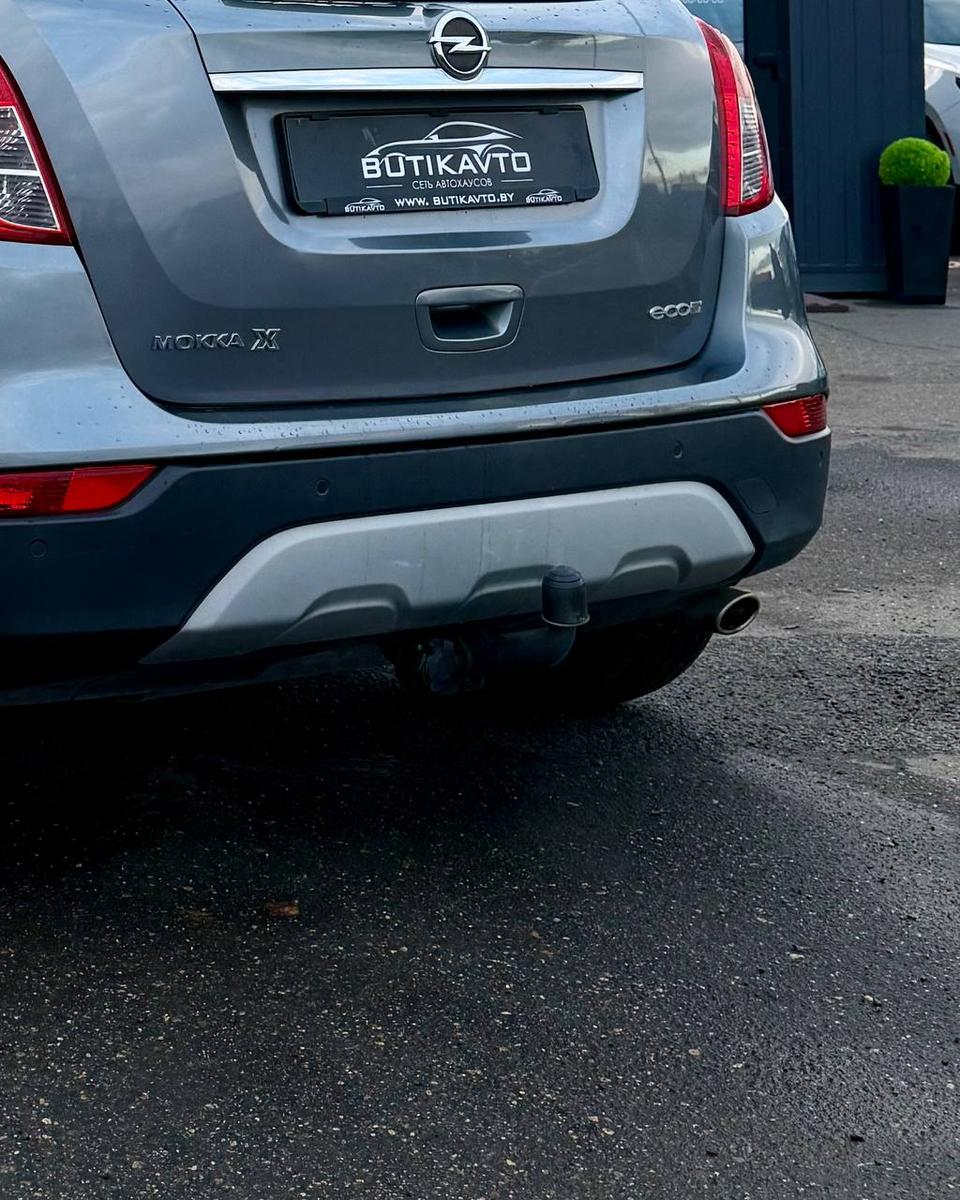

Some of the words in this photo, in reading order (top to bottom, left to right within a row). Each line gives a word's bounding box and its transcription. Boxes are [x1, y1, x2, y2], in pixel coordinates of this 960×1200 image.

[360, 152, 532, 179] BUTIKAVTO
[411, 180, 434, 190] СЕТЬ
[435, 177, 494, 189] АВТОХАУСОВ
[394, 196, 429, 208] WWW.
[433, 193, 515, 206] BUTIKAVTO.BY
[152, 332, 245, 350] MOKKA
[251, 328, 281, 350] X
